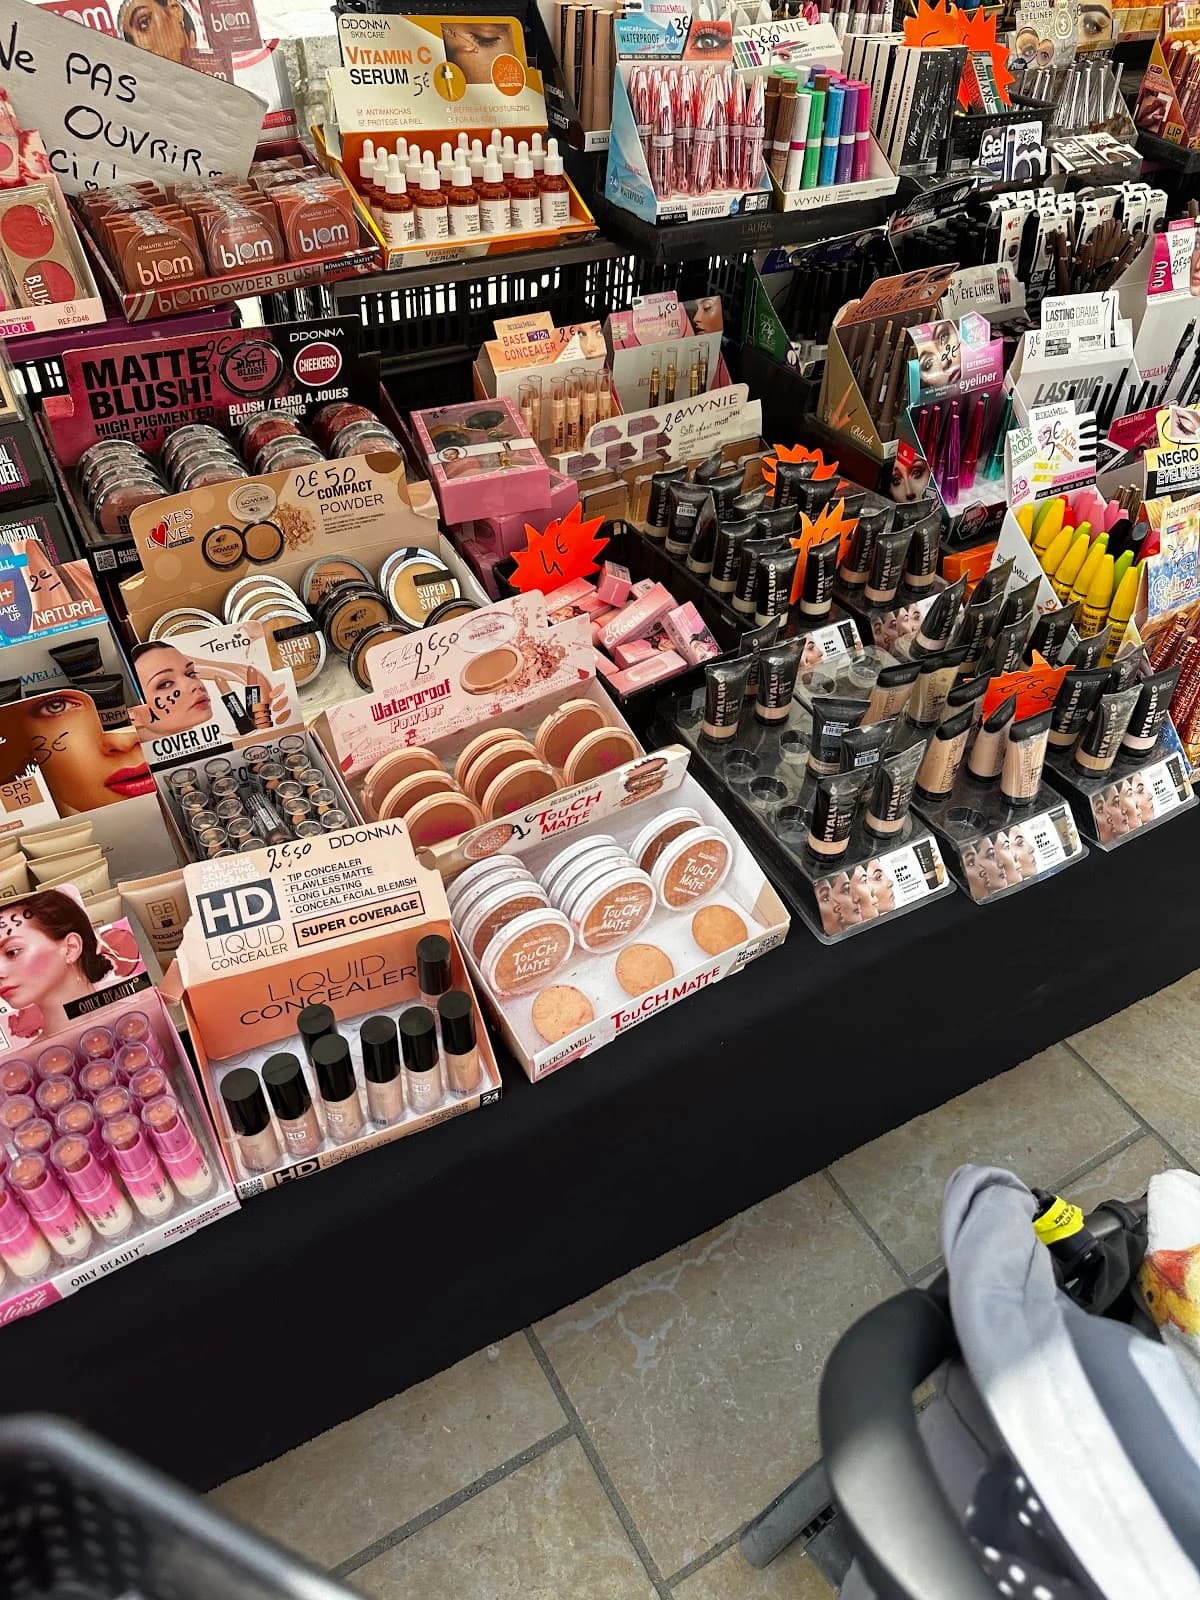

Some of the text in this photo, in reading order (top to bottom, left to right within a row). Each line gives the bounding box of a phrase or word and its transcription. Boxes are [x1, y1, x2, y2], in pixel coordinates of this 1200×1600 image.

[211, 12, 250, 33] blom
[341, 18, 391, 30] DDONNA
[1021, 11, 1054, 20] EYELINER
[674, 16, 690, 38] 3€
[743, 21, 809, 38] WYNIE
[620, 33, 660, 44] WATERPROOF
[345, 46, 432, 65] VITAMIN C
[66, 52, 138, 103] PAS
[350, 69, 409, 85] SERUM
[980, 82, 994, 105] SKY
[1167, 125, 1182, 136] LIP
[981, 133, 1005, 158] Gel
[691, 206, 725, 217] WATERPROOF
[793, 193, 832, 208] WYNIE
[299, 224, 349, 253] blom
[220, 240, 274, 268] blom
[429, 254, 458, 263] SERUM
[137, 255, 194, 286] blom
[211, 276, 273, 297] POWDER
[278, 265, 322, 285] BLUSH
[961, 283, 995, 300] EYE LINER
[1046, 305, 1099, 322] LASTING DRAMA
[290, 328, 344, 342] DDONNA
[503, 333, 526, 346] BASE
[559, 327, 577, 344] 2€
[504, 344, 557, 361] CONCEALER
[941, 343, 961, 362] 2€
[81, 346, 210, 390] MATTE
[299, 355, 337, 373] CHEEKERS!
[960, 372, 997, 391] eyeliner
[88, 375, 213, 420] BLUSH!
[229, 402, 265, 416] BLUSH
[274, 394, 303, 409] FARD
[305, 393, 313, 403] A
[315, 387, 349, 402] JOUES
[95, 405, 215, 436] HIGH PIGMENTED
[1042, 420, 1062, 461] 3€
[1157, 447, 1199, 468] NEGRO
[317, 480, 373, 500] COMPACT
[320, 493, 385, 515] POWDER
[164, 508, 194, 526] YES
[213, 543, 239, 555] POWDER
[766, 562, 777, 617] HYALURO
[815, 552, 825, 605] HYALURO
[416, 583, 448, 599] SUPER
[34, 599, 102, 626] NATURAL
[420, 597, 442, 611] STAY
[9, 612, 21, 622] UP
[200, 634, 251, 653] Tertio
[278, 636, 311, 656] SUPER
[282, 650, 306, 667] STAY
[371, 678, 451, 722] Waterproof
[1058, 680, 1083, 735] HYALURO
[390, 704, 445, 734] Powder
[1141, 685, 1159, 740] HYALURO
[152, 724, 220, 757] COVER UP
[1098, 703, 1118, 760] HYALURO
[1, 780, 34, 797] SPF
[15, 794, 31, 806] 15
[541, 809, 591, 836] MATTE
[823, 785, 837, 843] HYALURO
[329, 824, 404, 849] DDONNA
[288, 858, 362, 882] TIP CONCEALER
[290, 865, 373, 893] FLAWLESS MATTE
[292, 880, 362, 904] LONG LASTING
[680, 873, 706, 890] MATTE
[295, 876, 417, 915] CONCEAL FACIAL BLEMISH
[152, 903, 174, 915] BB
[201, 886, 273, 934] HD
[301, 900, 420, 938] SUPER COVERAGE
[601, 917, 632, 931] MATTE
[206, 924, 285, 960] LIQUID
[211, 943, 289, 971] CONCEALER
[515, 956, 550, 976] MATTE
[267, 955, 386, 1002] LIQUID
[672, 967, 720, 1000] MATTE
[79, 981, 136, 1014] ONLY BEAUTY
[240, 964, 418, 1026] CONCEALER
[411, 1083, 431, 1093] HD
[482, 1092, 499, 1106] 24
[285, 1131, 306, 1141] HD
[275, 1160, 318, 1185] HD
[320, 1140, 368, 1163] LIQUID
[321, 1137, 393, 1167] CONCEALER
[71, 1246, 141, 1288] ONLY BEAUTY
